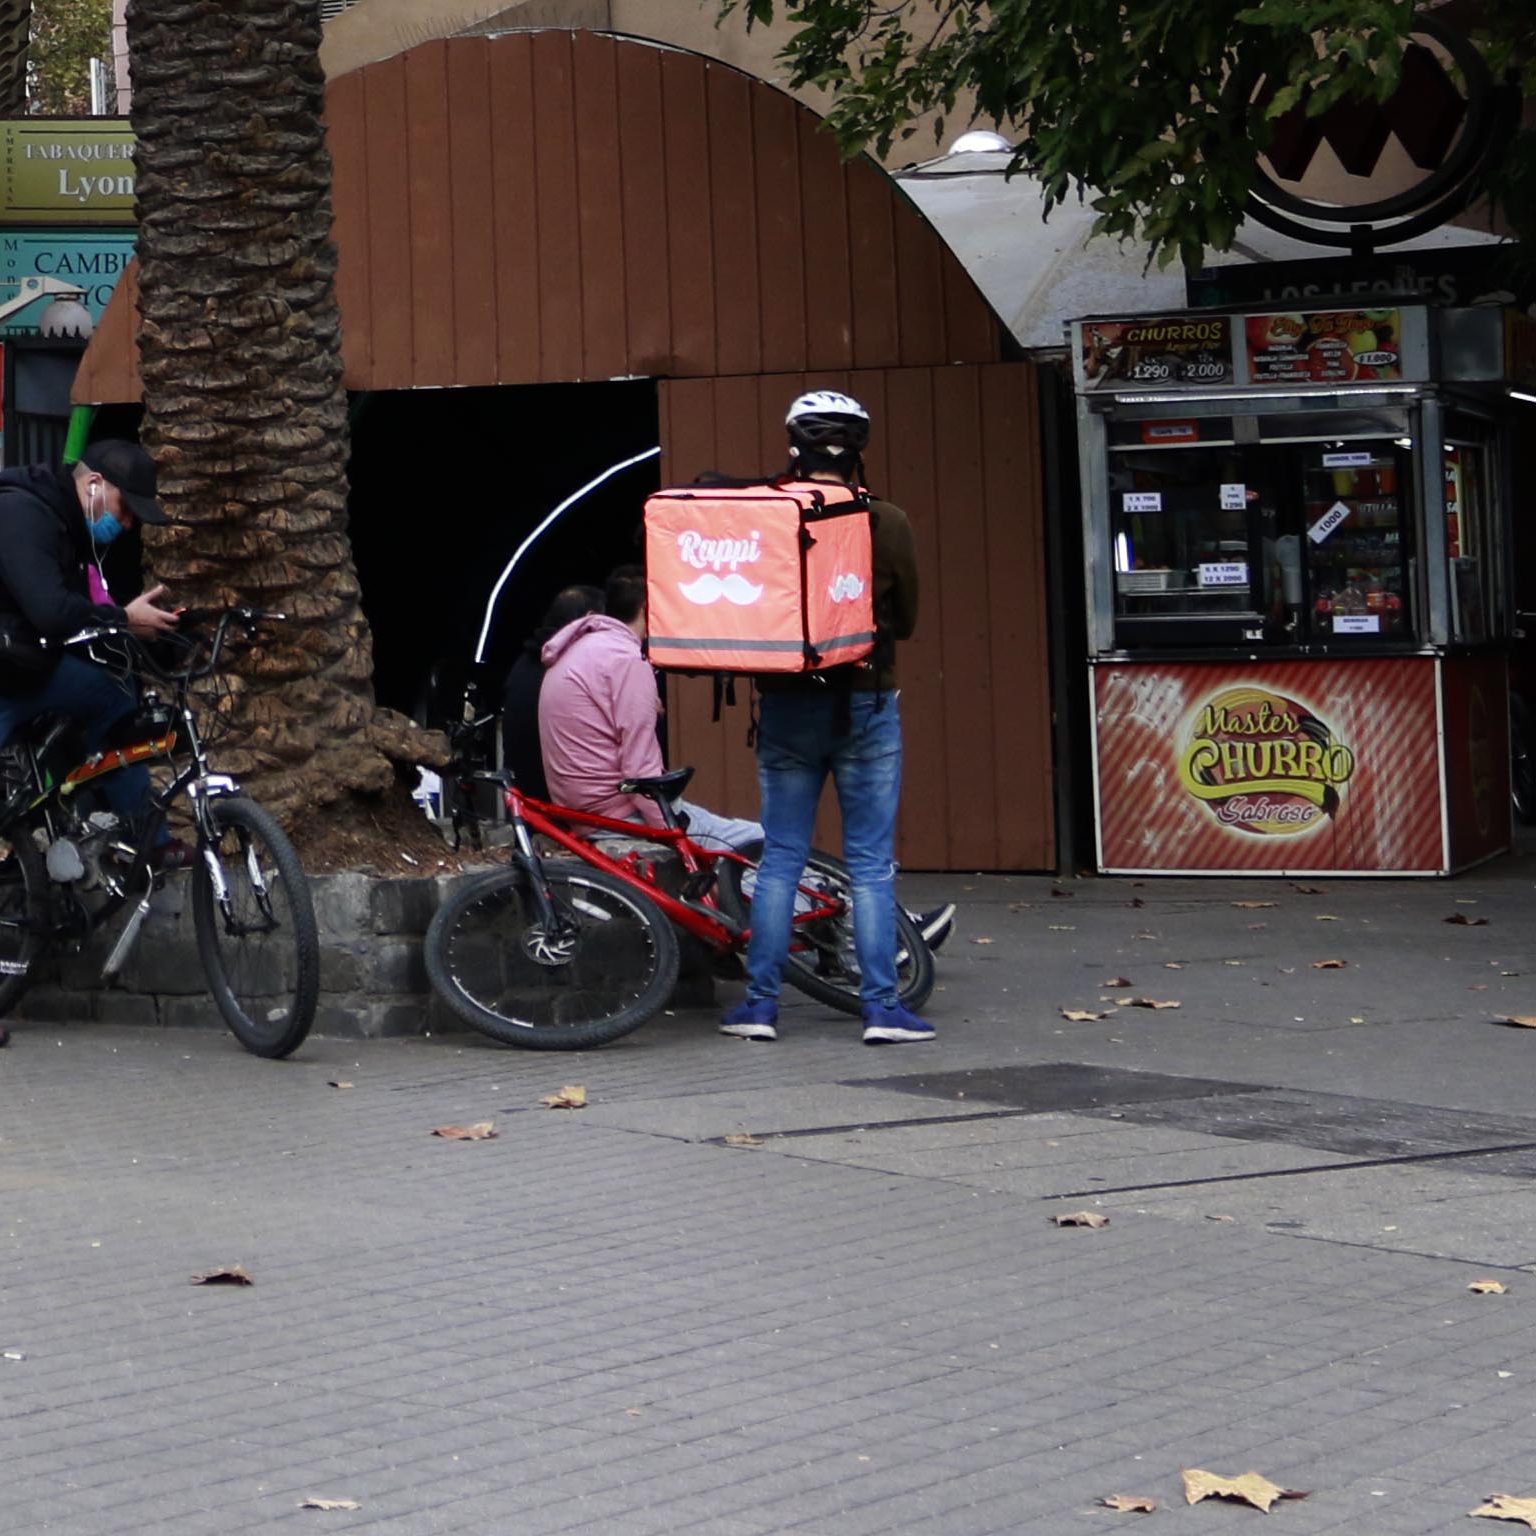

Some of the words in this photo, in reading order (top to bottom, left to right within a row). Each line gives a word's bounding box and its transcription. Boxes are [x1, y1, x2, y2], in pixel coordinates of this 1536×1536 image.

[59, 169, 134, 202] Lyon
[1127, 322, 1223, 342] CHURROS
[1318, 510, 1343, 534] 1000
[677, 530, 761, 571] Rappi
[1194, 701, 1300, 735] Master
[1180, 737, 1354, 792] CHURRO
[1217, 796, 1316, 825] Sabroso
